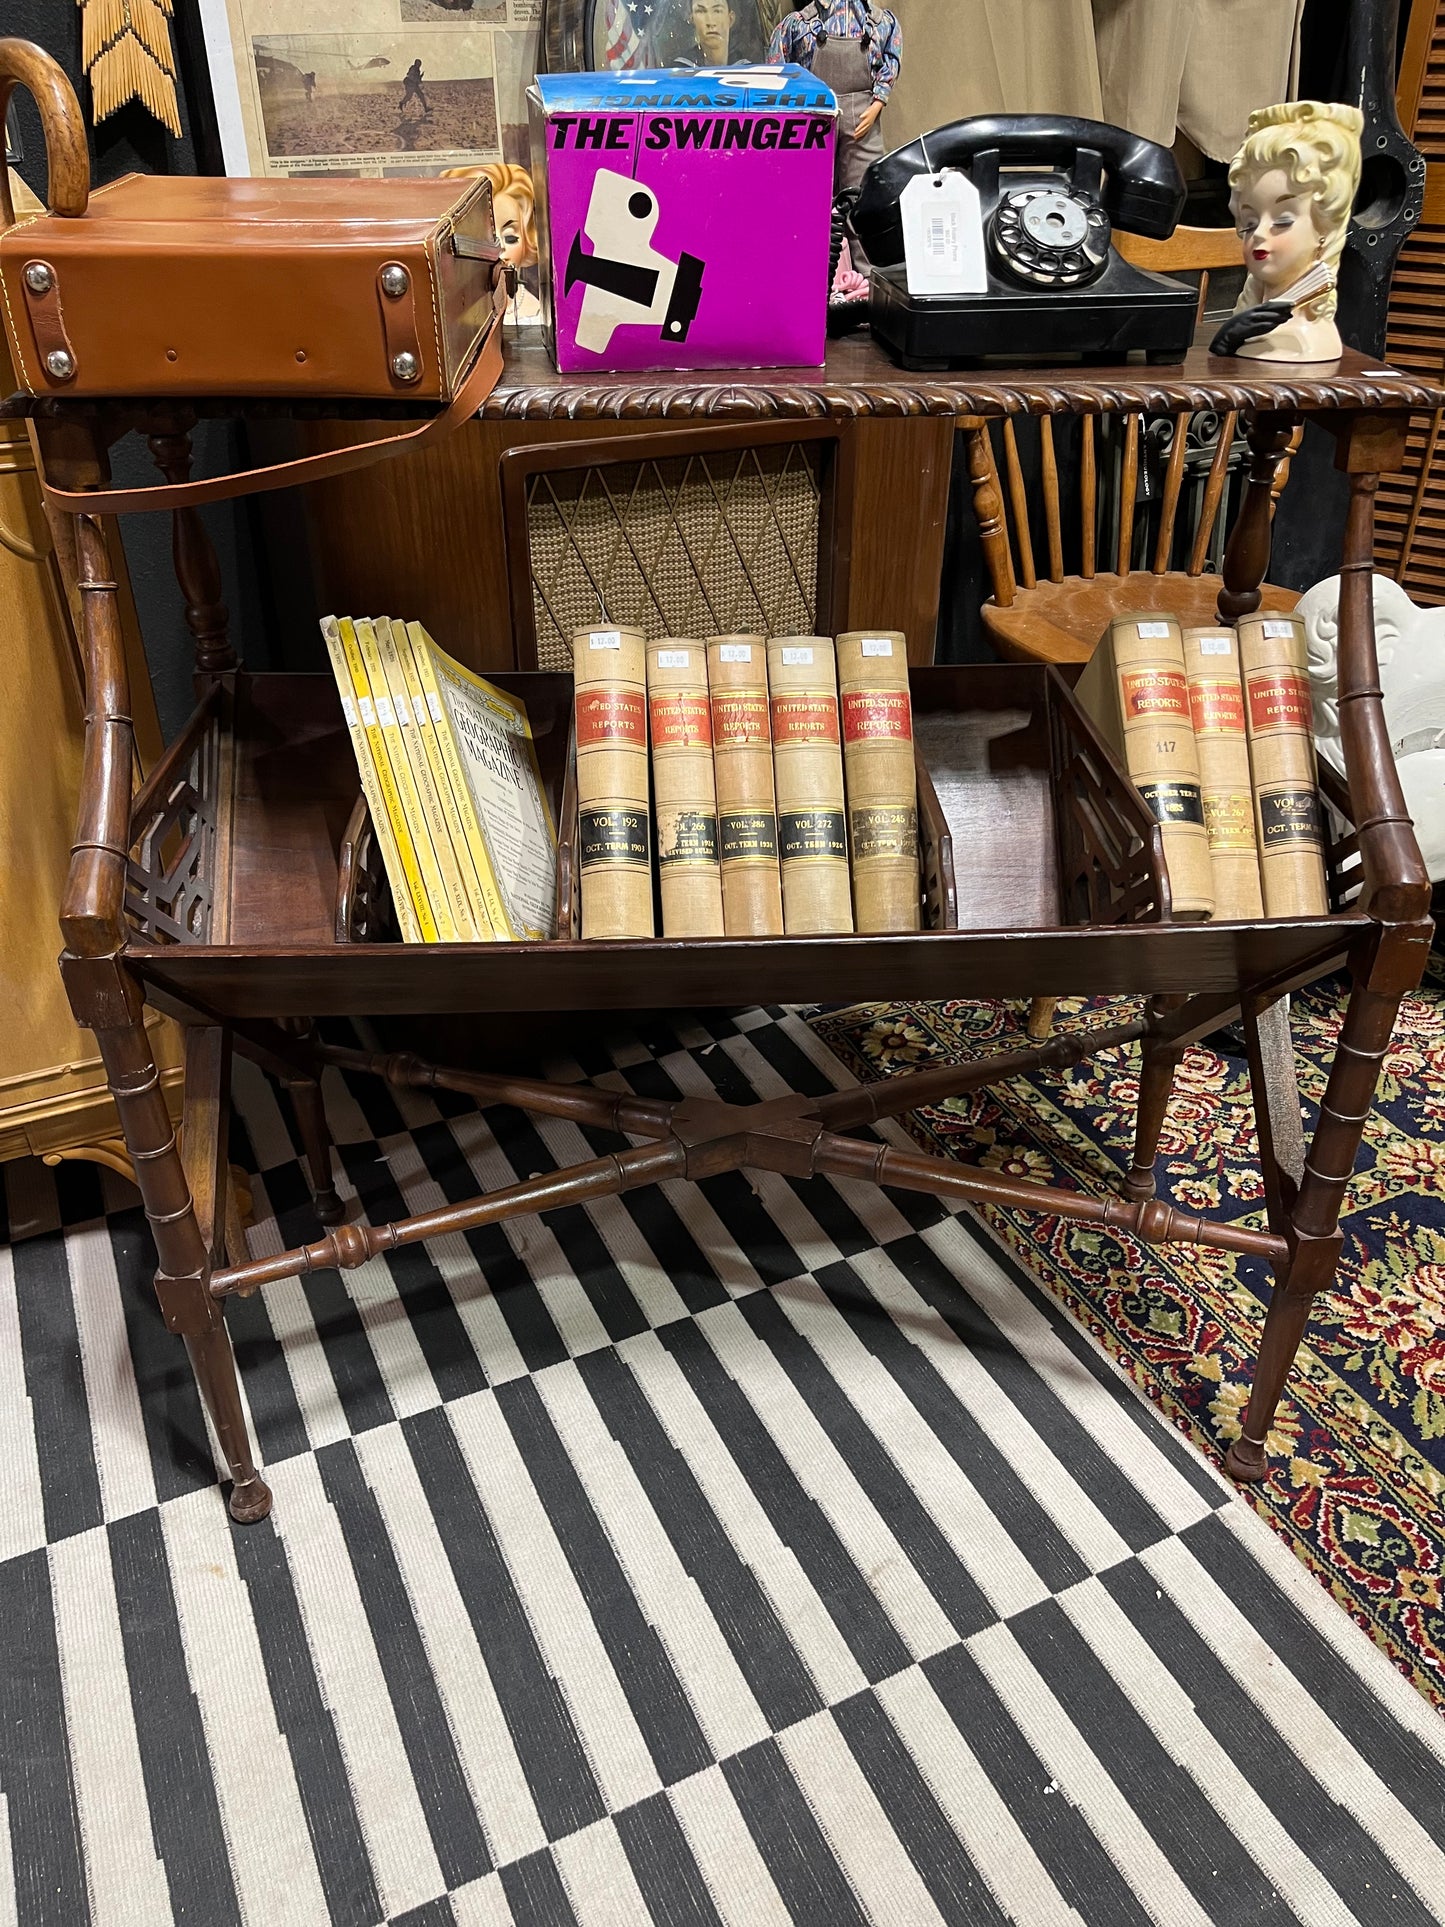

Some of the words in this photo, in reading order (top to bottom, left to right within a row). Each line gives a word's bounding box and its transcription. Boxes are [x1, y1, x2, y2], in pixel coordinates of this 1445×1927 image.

[753, 93, 834, 108] THE
[550, 118, 634, 150] THE
[645, 117, 832, 150] SWINGER
[1127, 678, 1156, 688] UNITED
[1157, 677, 1186, 689] STATES
[1191, 694, 1219, 704] UNITED
[1254, 688, 1286, 700] UNITED
[614, 702, 642, 714] STATES
[777, 703, 808, 714] UNITED
[849, 698, 876, 710] UNITED
[876, 698, 907, 708] STATES
[1137, 698, 1181, 710] REPORTS
[654, 706, 682, 718] UNITED
[1204, 711, 1237, 720] REPORTS
[1267, 706, 1307, 716] REPORTS
[450, 690, 466, 713] THE
[464, 702, 513, 745] NATIONAL
[592, 720, 635, 730] REPORTS
[664, 724, 699, 734] REPORTS
[724, 722, 760, 732] REPORTS
[788, 722, 825, 731] REPORTS
[857, 721, 901, 731] REPORTS
[454, 708, 521, 770] GEOGRAPHIC
[1156, 741, 1176, 753] 117
[464, 735, 524, 791] MAGAZINE
[373, 741, 385, 766] NATIONAL
[381, 769, 395, 803] GEOGRAPHIC
[391, 804, 403, 833] MAGAZINE
[412, 740, 424, 768] NATIONAL
[420, 769, 434, 804] GEOGRAPHIC
[430, 805, 442, 833] MAGAZINE
[443, 742, 456, 767] NATIONAL
[451, 768, 465, 802] GEOGRAPHIC
[461, 803, 473, 830] MAGAZINE
[592, 816, 616, 828] VOL.
[622, 817, 638, 828] 192
[692, 822, 706, 830] 266
[730, 820, 748, 830] VOL.
[795, 820, 814, 829] VOL.
[817, 820, 832, 828] 272
[1267, 824, 1288, 834] OCT.
[1290, 823, 1312, 832] TERM
[586, 844, 604, 854] OCT.
[605, 842, 628, 851] TERM
[631, 843, 645, 852] 1903
[786, 842, 802, 850] OCT.
